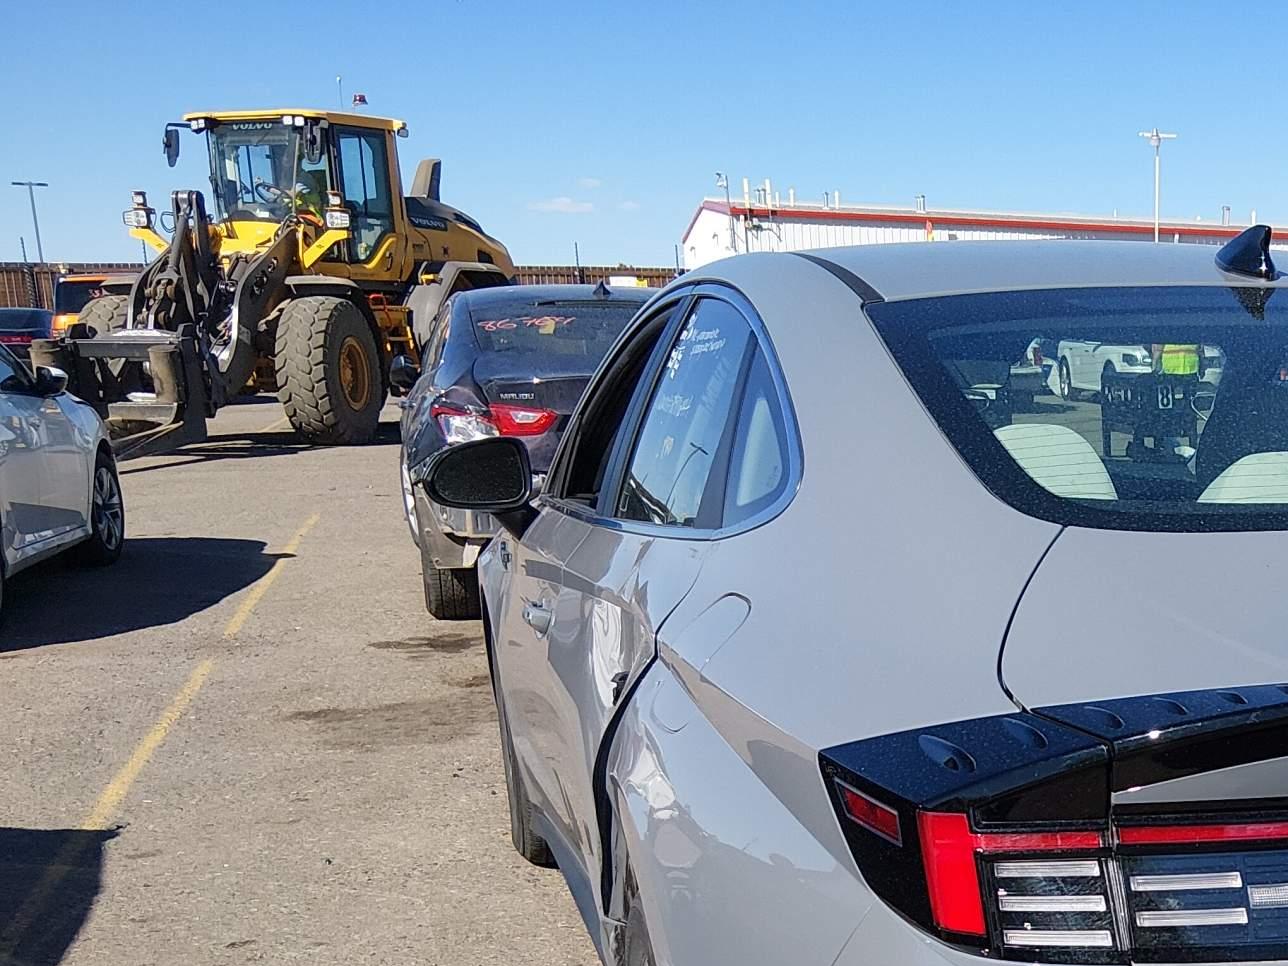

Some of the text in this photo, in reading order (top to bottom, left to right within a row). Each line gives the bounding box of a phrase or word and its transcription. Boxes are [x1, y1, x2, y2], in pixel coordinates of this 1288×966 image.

[232, 122, 273, 130] VOLVO
[410, 216, 446, 228] VOLVO
[499, 392, 535, 400] MALIBU
